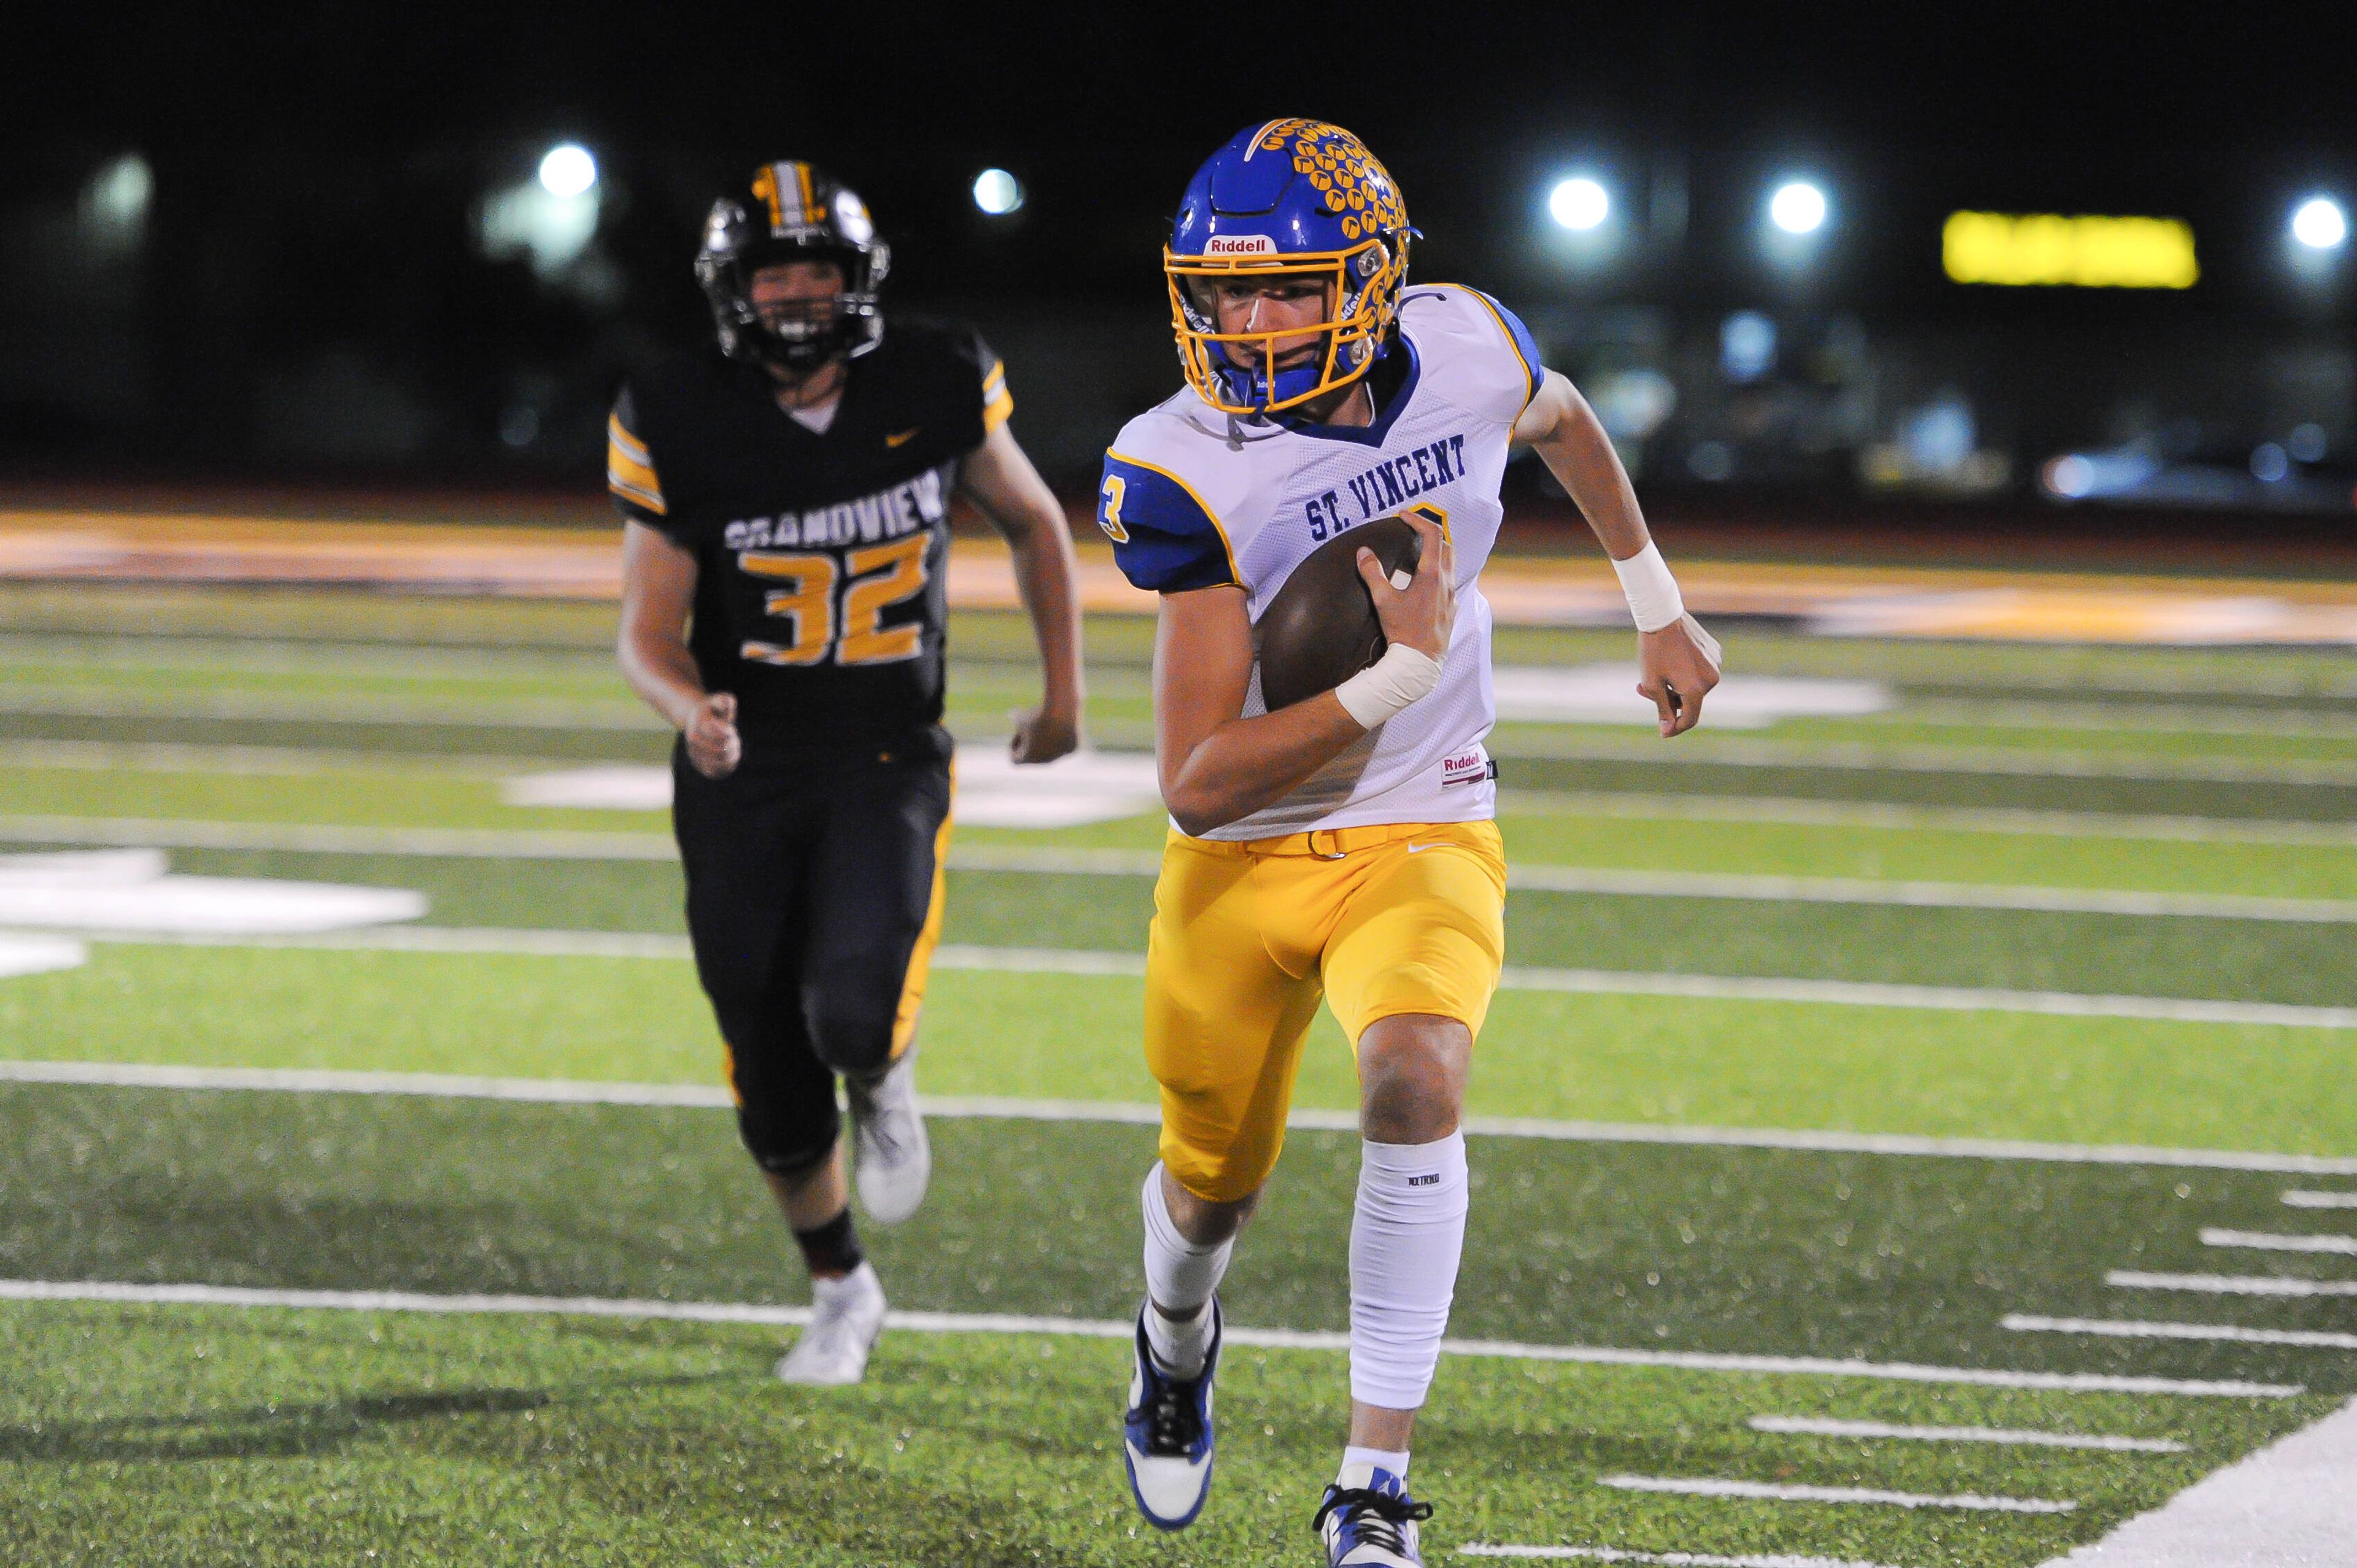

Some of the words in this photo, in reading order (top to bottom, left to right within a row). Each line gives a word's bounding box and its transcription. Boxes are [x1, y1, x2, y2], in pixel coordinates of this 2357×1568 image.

[1212, 239, 1265, 252] Riddell
[1099, 474, 1130, 544] 3
[1306, 490, 1350, 541] ST.
[1348, 434, 1465, 518] VINCENT
[738, 530, 933, 666] 32
